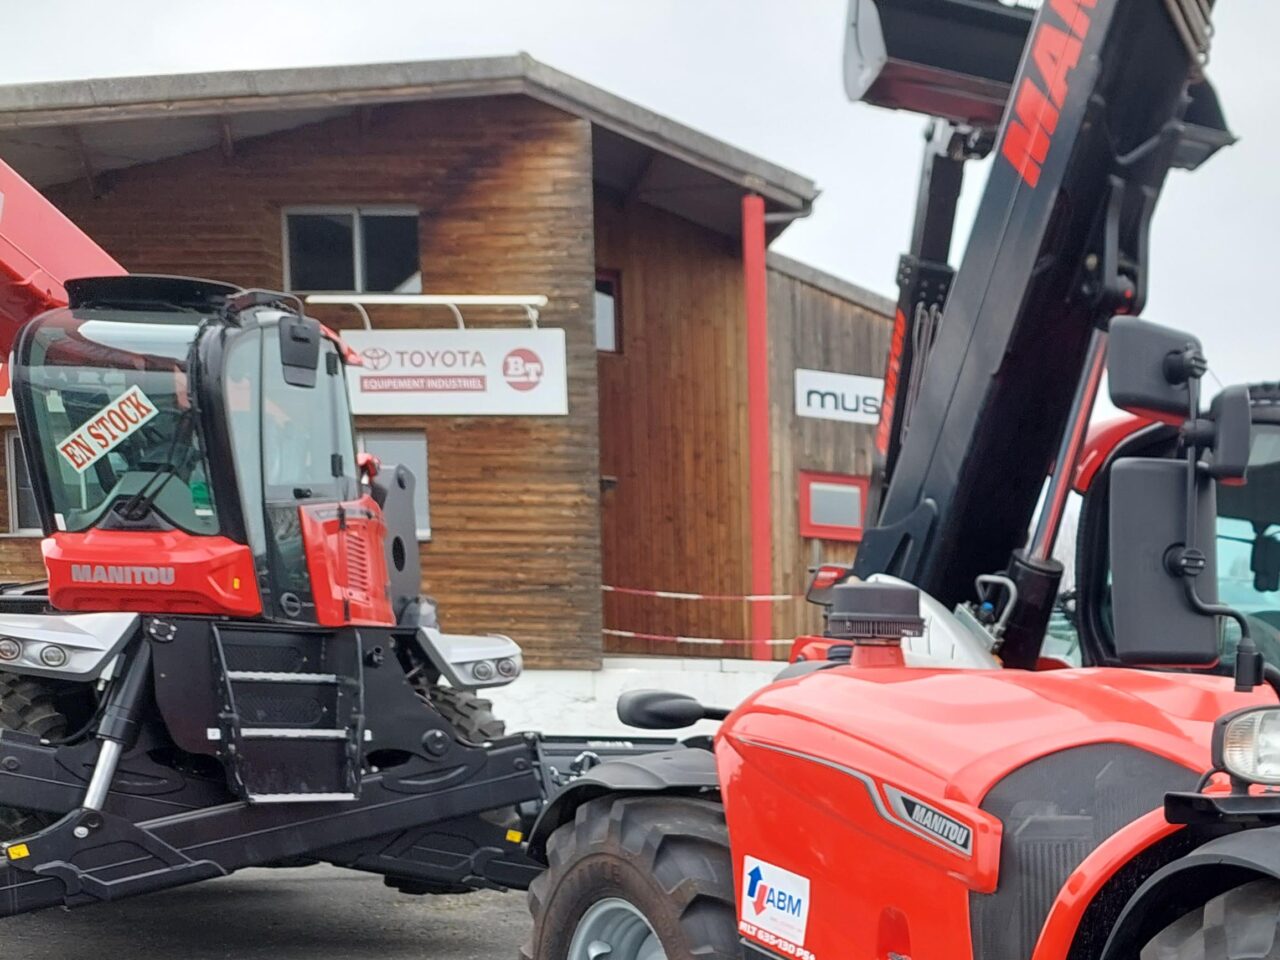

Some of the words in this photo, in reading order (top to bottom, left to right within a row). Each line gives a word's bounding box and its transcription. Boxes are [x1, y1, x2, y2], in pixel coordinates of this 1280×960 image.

[396, 351, 487, 367] TOYOTA
[506, 355, 542, 382] BT
[363, 378, 426, 390] EQUIPEMENT
[427, 378, 484, 390] INDUSTRIEL
[61, 433, 97, 469] EN
[87, 391, 152, 450] STOCK
[71, 564, 175, 585] MANITOU
[912, 804, 968, 845] MANITOU
[766, 888, 802, 917] ABM
